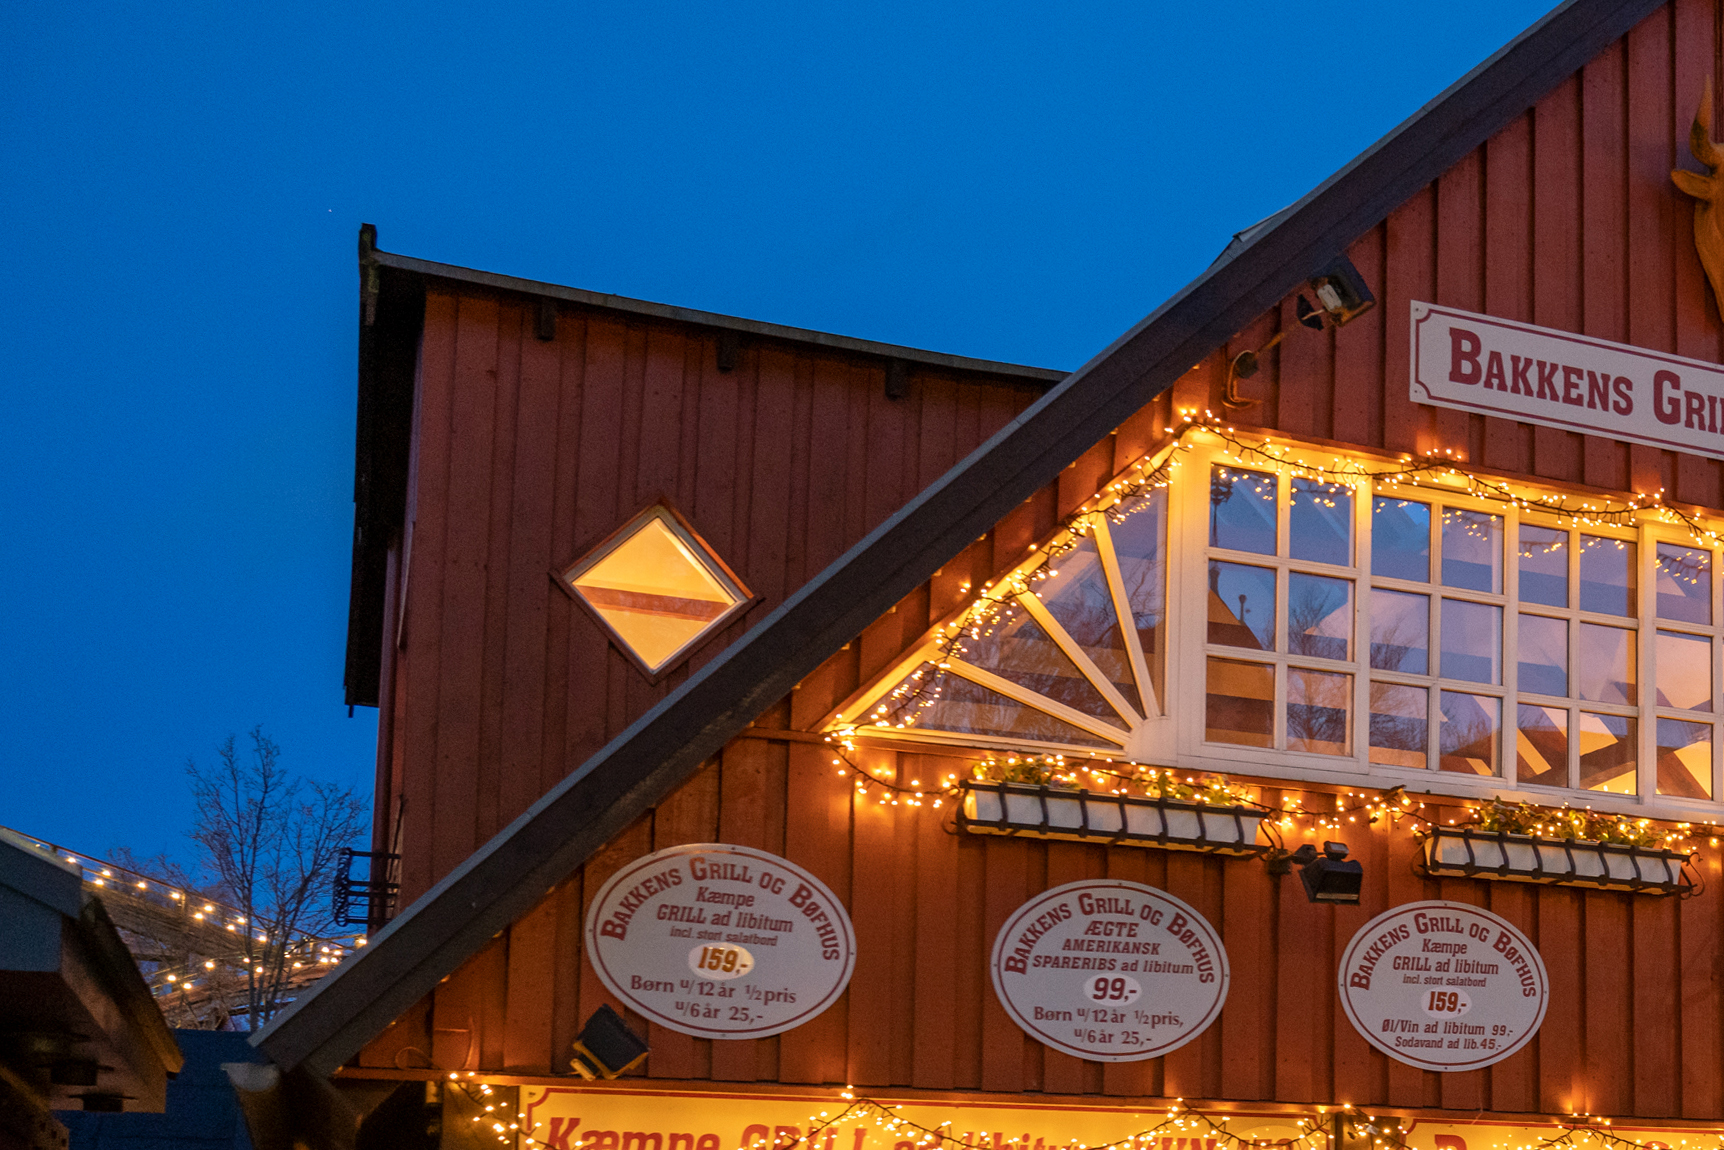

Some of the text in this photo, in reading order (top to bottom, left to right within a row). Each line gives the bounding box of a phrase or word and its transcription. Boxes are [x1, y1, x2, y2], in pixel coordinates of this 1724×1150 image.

[1448, 326, 1633, 417] BAKKENS
[696, 887, 755, 910] Kæmpe
[600, 857, 840, 961] BAKKENS GRILL OG BØFHUS
[657, 904, 793, 933] GRILL ad libitum
[697, 929, 722, 941] stort
[726, 930, 778, 947] salatbord
[1004, 893, 1215, 984] BAKKENS GRILL OG BØFHUS
[1084, 921, 1139, 938] ÆGTE
[1062, 939, 1161, 955] AMERIKANSK
[1350, 912, 1537, 998] BAKKENS GRILL OG BØFHUS
[1422, 939, 1468, 957] Kæmpe
[1032, 955, 1194, 974] SPARERIBS ad libitum
[1393, 956, 1499, 974] GRILL ad libitum
[1424, 975, 1443, 986] stort
[1445, 977, 1487, 987] salatbord
[1034, 1006, 1073, 1021] Børn
[1382, 1019, 1419, 1033] Øl/Vin
[1424, 1021, 1439, 1033] ad
[1444, 1022, 1485, 1035] libitum
[1395, 1036, 1443, 1048] Sodavand
[1447, 1038, 1460, 1049] ad
